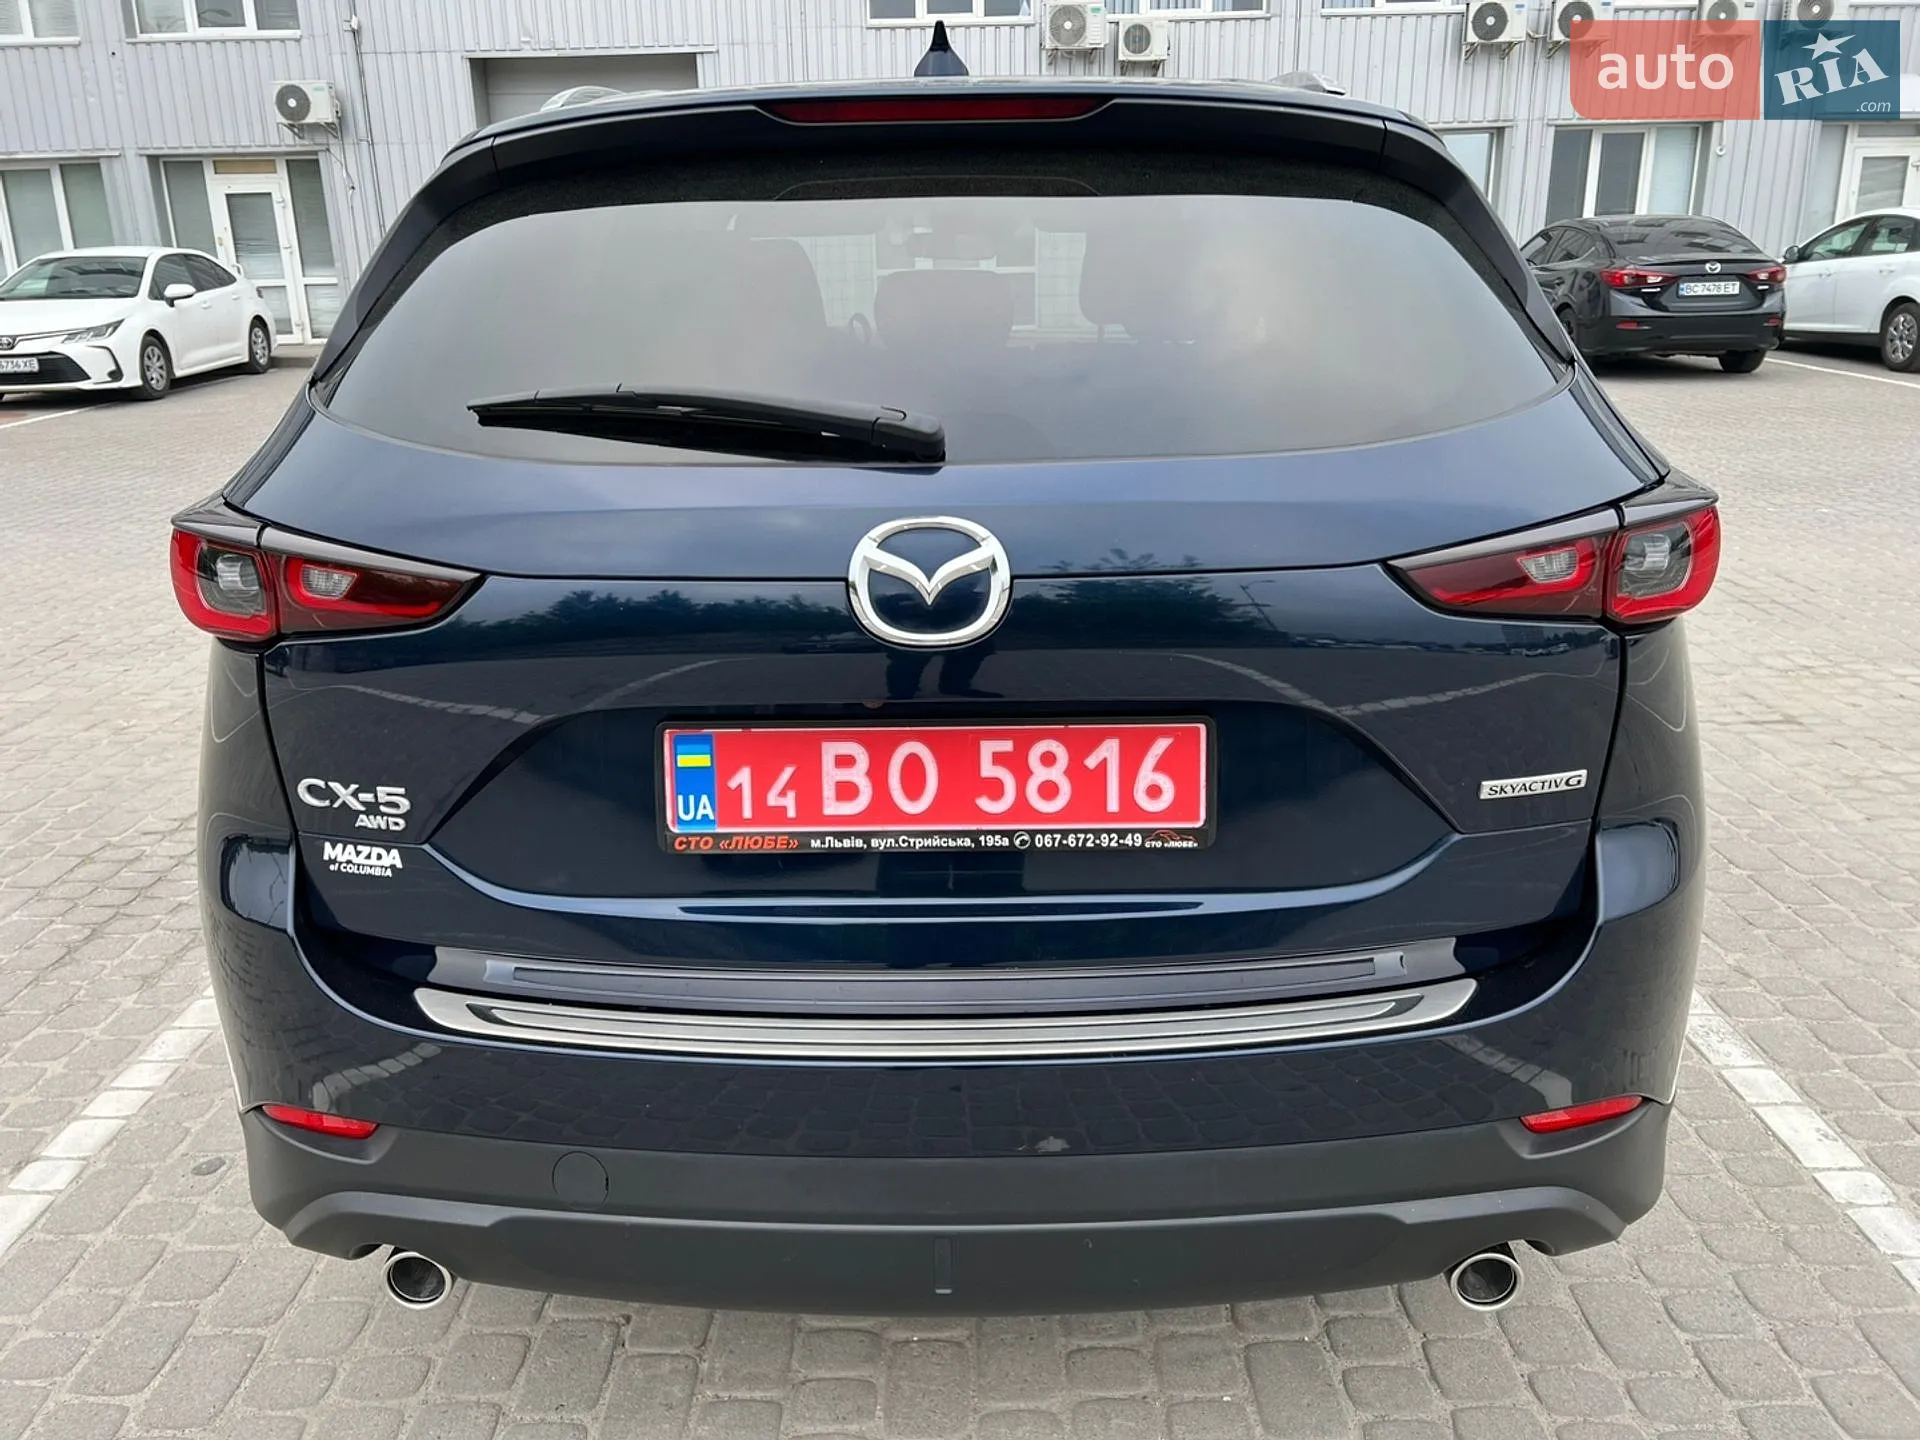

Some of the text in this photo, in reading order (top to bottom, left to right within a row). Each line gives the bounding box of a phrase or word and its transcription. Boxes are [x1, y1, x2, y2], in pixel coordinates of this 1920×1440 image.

[1685, 283, 1699, 295] BC
[1724, 282, 1738, 293] ET
[726, 736, 1176, 820] 14 BO 5816
[297, 778, 411, 815] CX-5
[677, 793, 715, 822] UA
[355, 813, 407, 832] AWD
[674, 836, 714, 851] СТО
[1034, 832, 1142, 849] 067-672-92-49
[323, 841, 403, 869] MAZDA
[329, 862, 393, 878] of COLUMBIA
